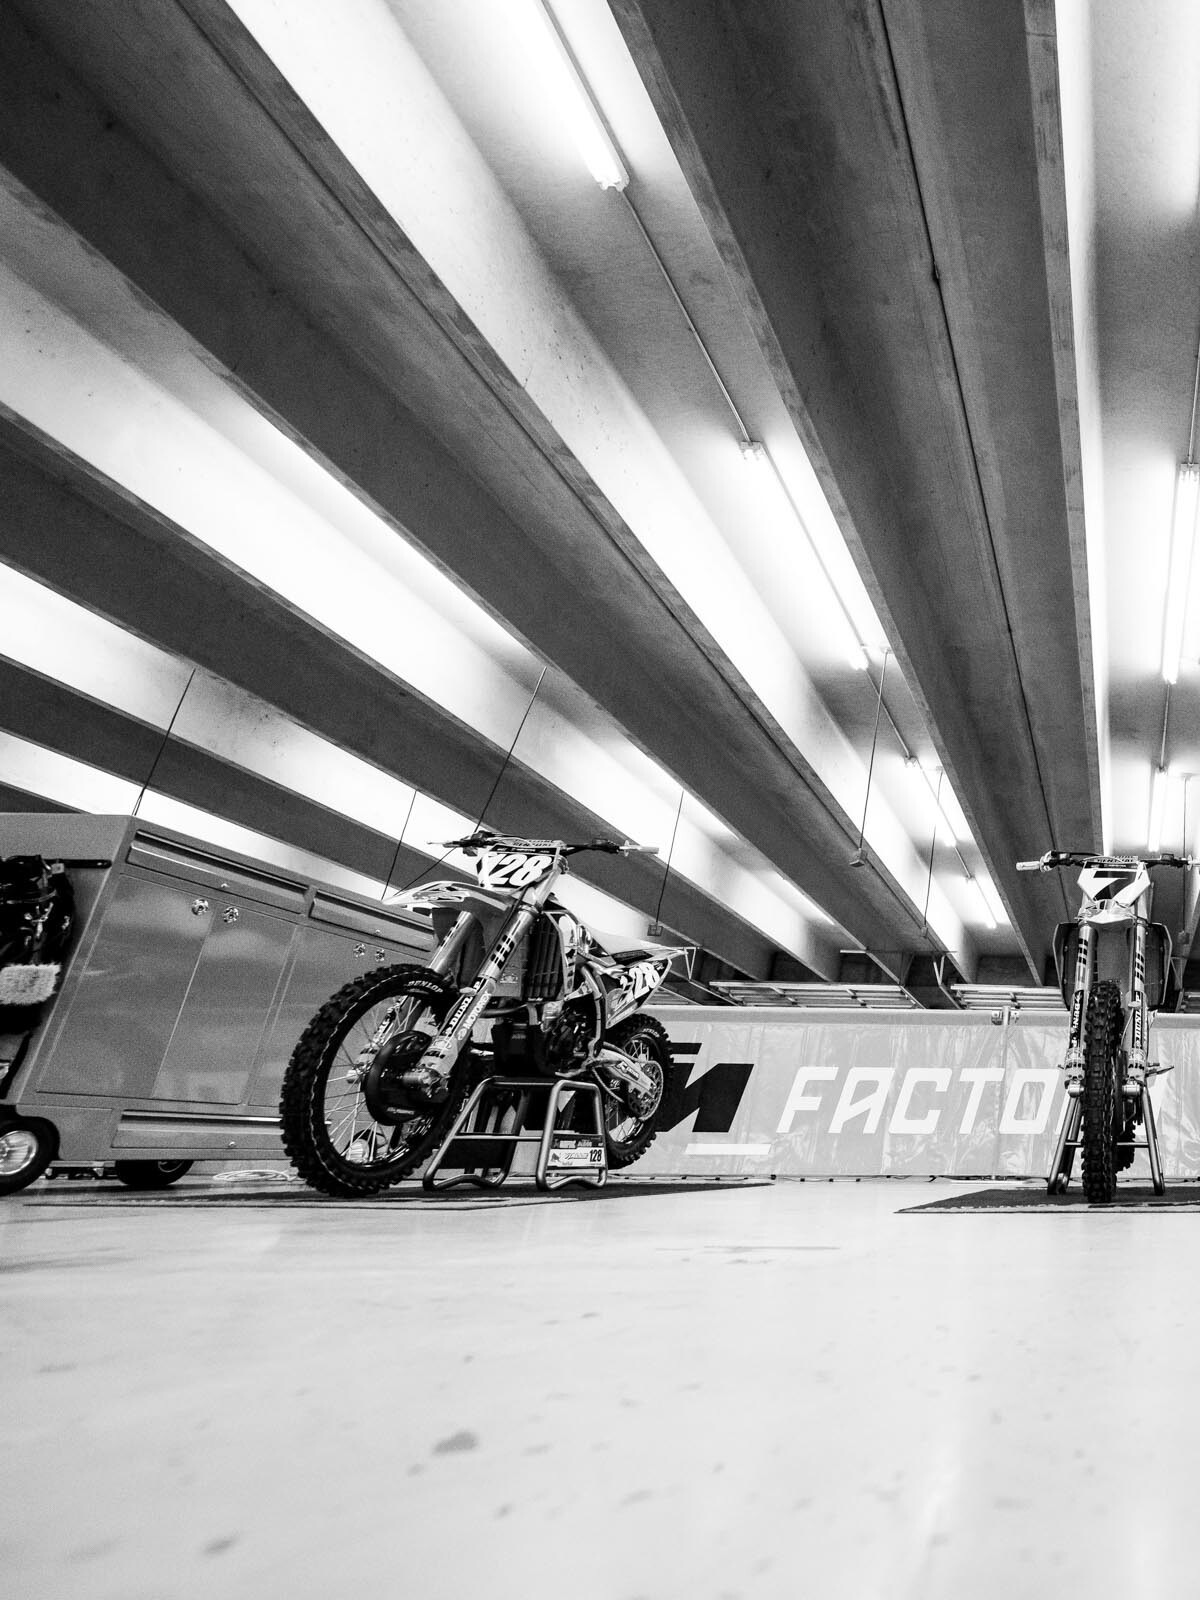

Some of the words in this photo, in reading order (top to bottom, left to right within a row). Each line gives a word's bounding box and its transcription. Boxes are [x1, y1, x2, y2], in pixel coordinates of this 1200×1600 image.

[1093, 870, 1138, 902] 7
[407, 980, 444, 993] DUNLOP
[448, 980, 482, 1027] DUNLP
[462, 990, 492, 1030] MOTOREX
[590, 1149, 603, 1162] 128
